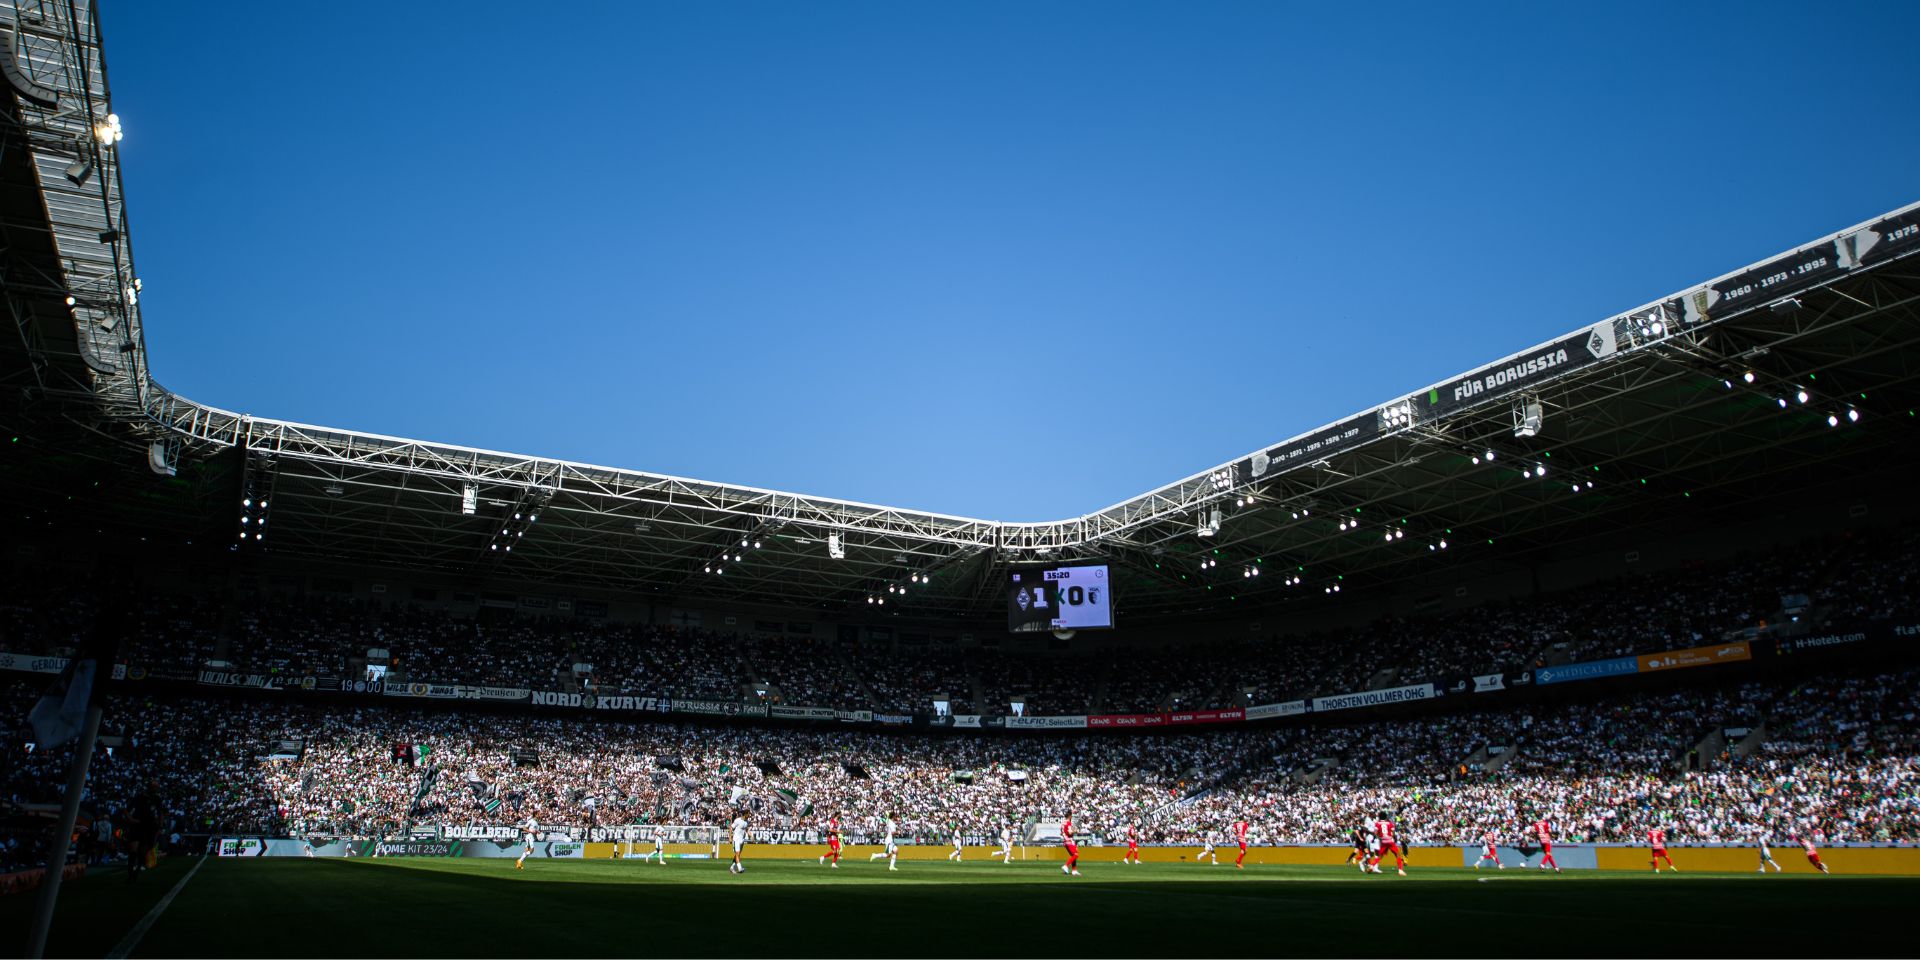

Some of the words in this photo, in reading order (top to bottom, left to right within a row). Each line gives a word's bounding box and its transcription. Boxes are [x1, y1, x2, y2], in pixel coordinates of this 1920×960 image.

[1887, 223, 1919, 242] 1975
[1724, 285, 1751, 300] 1960
[1761, 271, 1788, 288] 1973
[1797, 257, 1827, 274] 1995
[1454, 379, 1484, 401] FÜR
[1486, 349, 1569, 389] BORUSSIA
[1272, 454, 1286, 465] 1970
[1047, 571, 1070, 579] 35:20
[1033, 587, 1048, 608] 1
[1068, 586, 1084, 606] 0
[1795, 632, 1866, 649] H-Hotels.com
[1556, 663, 1602, 680] MEDICAL
[1608, 660, 1637, 673] PARK
[531, 690, 582, 707] NORD
[597, 696, 658, 711] KURVE
[674, 700, 720, 711] BORUSSIA
[1321, 695, 1362, 710] THORSTEN
[1363, 692, 1403, 706] VOLLMER
[1404, 687, 1425, 699] OHG
[1219, 711, 1241, 719] ELTEN
[407, 844, 421, 853] KIT
[423, 844, 448, 854] 23/24
